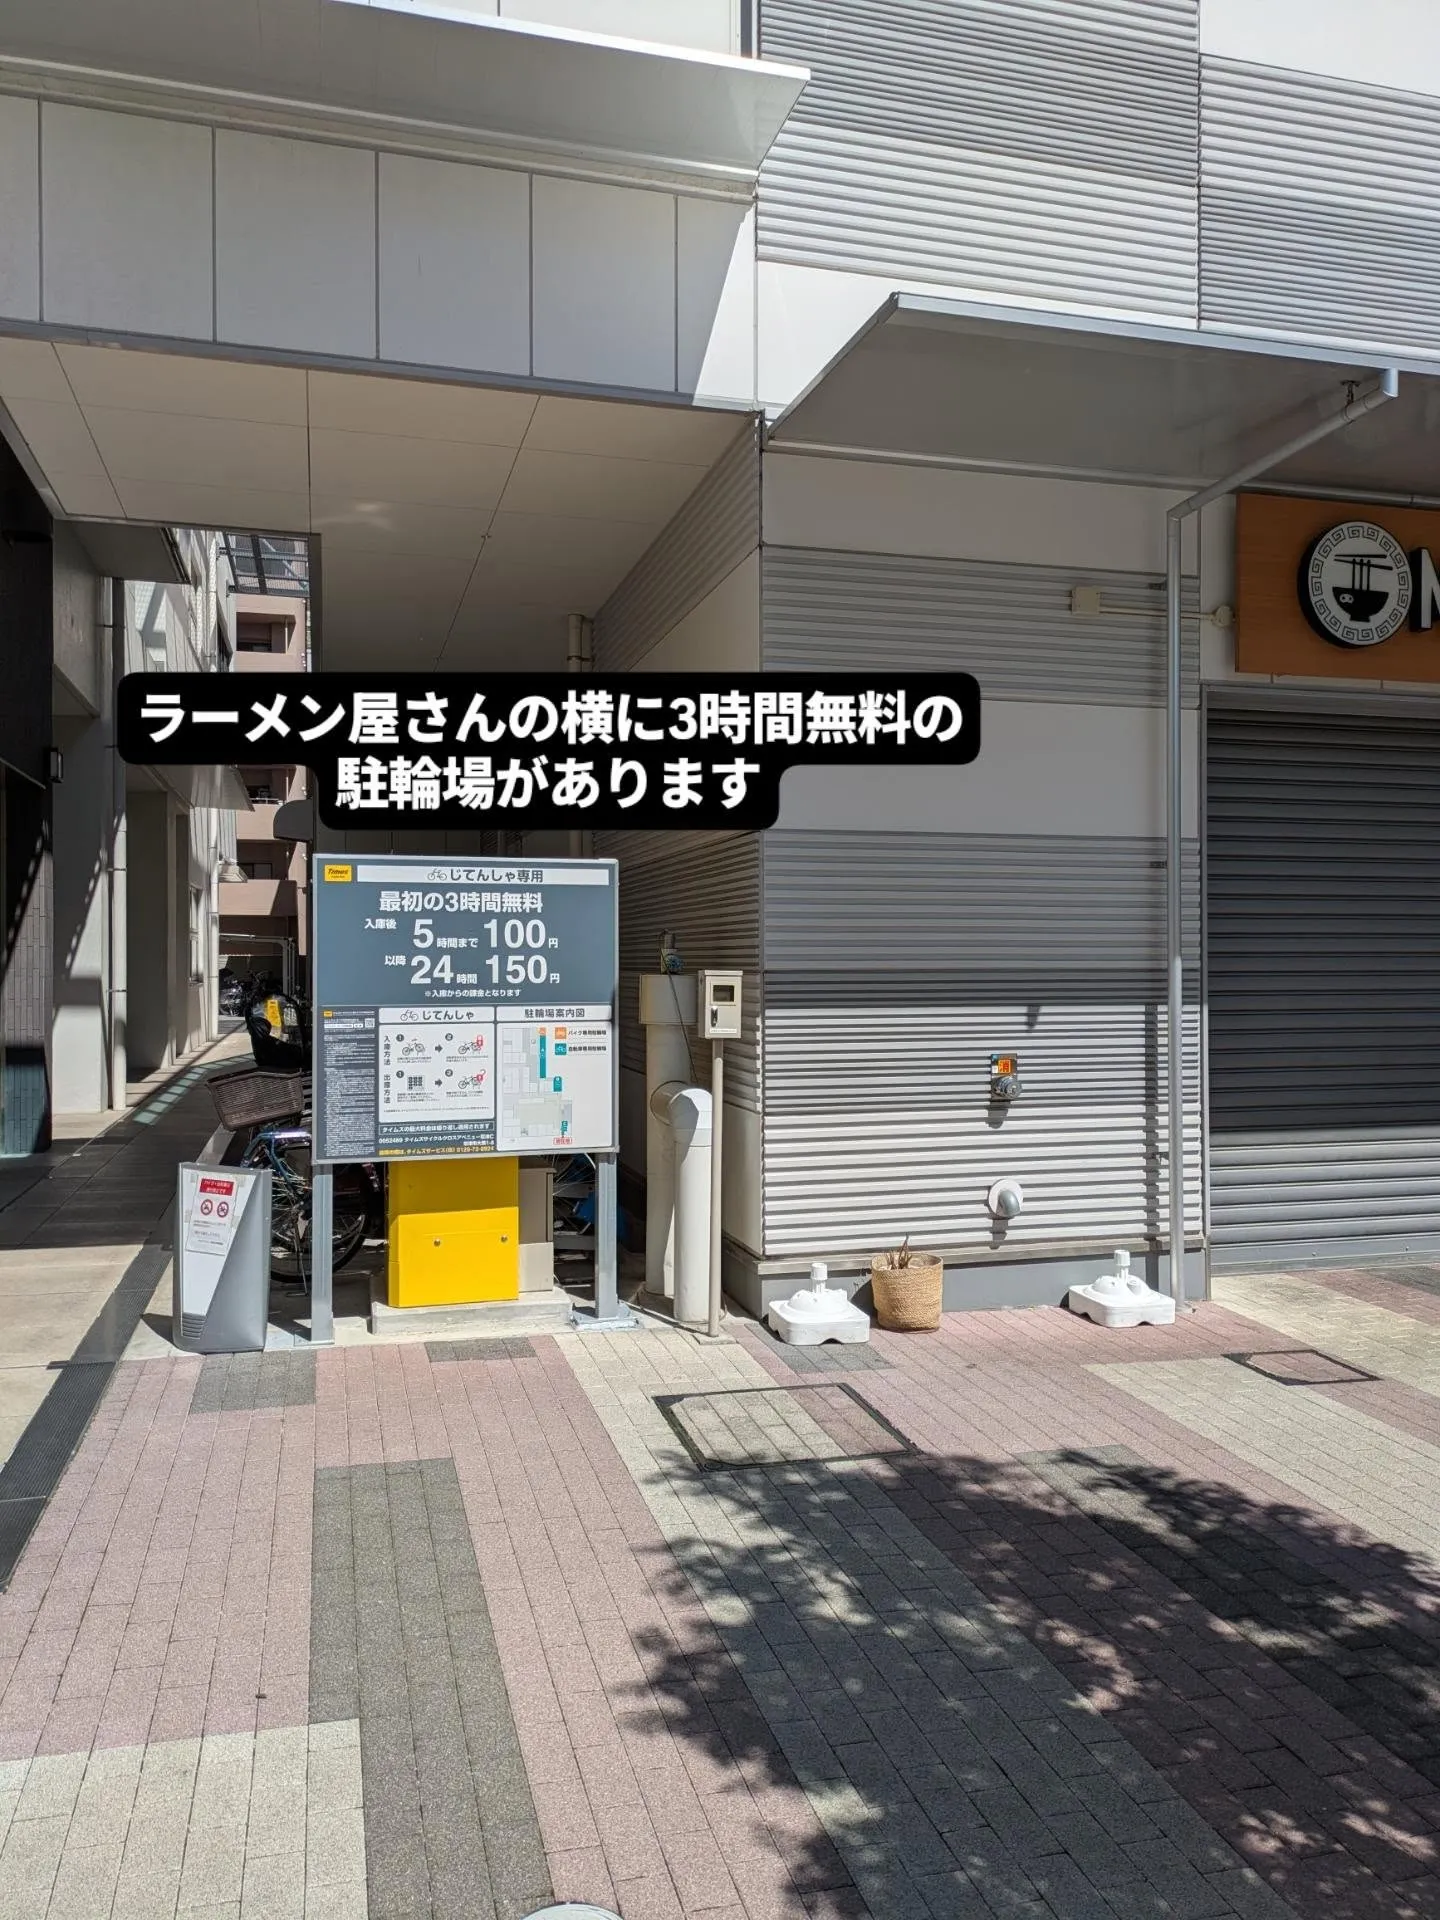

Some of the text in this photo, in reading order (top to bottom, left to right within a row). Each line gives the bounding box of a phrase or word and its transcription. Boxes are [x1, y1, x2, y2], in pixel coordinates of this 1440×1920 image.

[450, 869, 544, 883] じてんしゃ専用
[379, 891, 543, 913] 最初の3時間無料
[364, 918, 397, 929] 入庫後
[384, 955, 406, 966] 以降
[422, 1010, 474, 1020] じてんしゃ
[524, 1008, 585, 1018] 駐輪場案内図
